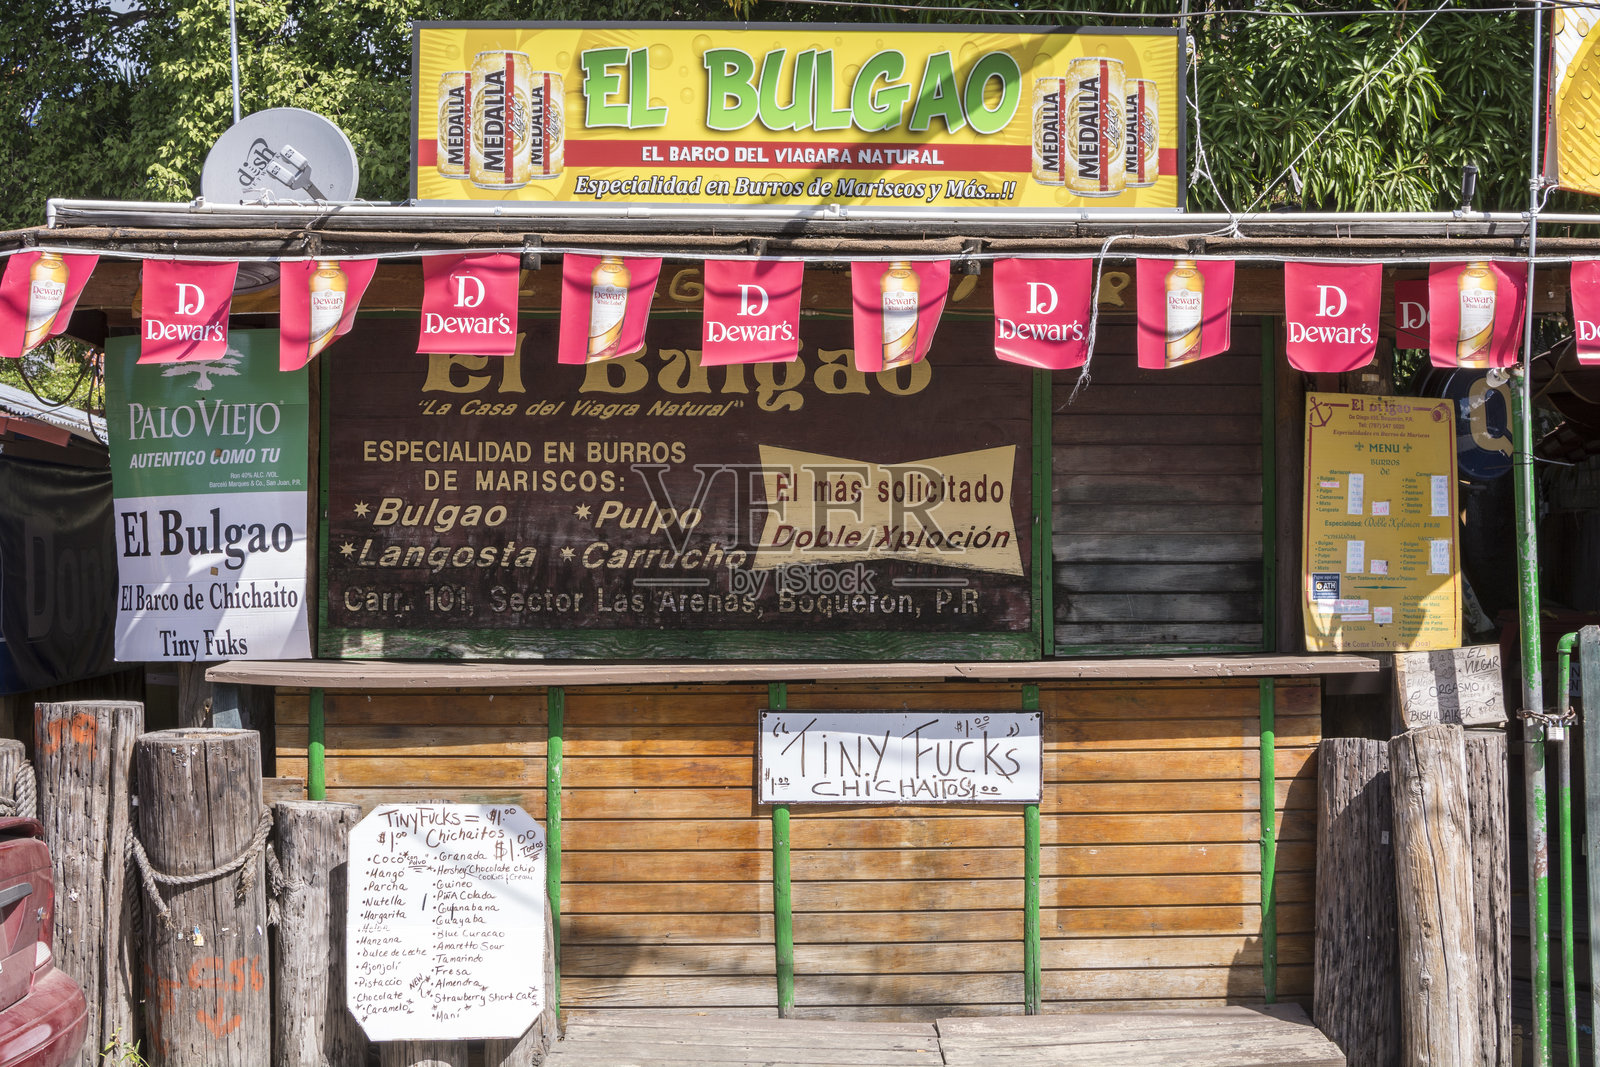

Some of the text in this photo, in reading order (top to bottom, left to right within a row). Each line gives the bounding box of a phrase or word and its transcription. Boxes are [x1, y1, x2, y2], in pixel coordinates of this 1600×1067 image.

[581, 46, 668, 129] EL
[704, 48, 1022, 134] BULGAO
[448, 84, 465, 166] MEDALLA
[483, 68, 505, 173] MEDALLA
[1078, 75, 1100, 180] MEDALLA
[1042, 92, 1059, 173] MEDALLA
[642, 147, 944, 165] EL BARCO DEL VIAGARA NATURAL
[574, 175, 701, 198] Especialidad
[706, 180, 729, 196] en
[734, 177, 804, 197] Burros
[807, 178, 831, 197] de
[836, 178, 926, 198] Mariscos
[926, 183, 943, 202] y
[460, 400, 518, 416] Casa
[525, 399, 564, 416] del
[571, 400, 641, 420] Viagra
[1351, 399, 1364, 411] El
[363, 441, 686, 463] ESPECIALIDAD EN BURROS
[1369, 443, 1400, 453] MENU
[130, 448, 281, 469] AUTENTICO COMO TU
[424, 470, 625, 492] DE MARISCOS:
[776, 473, 1004, 503] El más solicitado
[373, 498, 508, 533] Bulgao
[595, 500, 702, 534] Pulpo
[121, 507, 294, 570] El Bulgao
[772, 524, 1011, 552] Doble Xploción
[358, 539, 537, 573] Langosta
[581, 541, 747, 570] Carrucho
[121, 581, 298, 611] El Barco de Chichaito
[491, 585, 584, 613] Sector
[597, 587, 645, 613] Las
[658, 589, 764, 619] Arenas,
[779, 589, 922, 619] Boqueron,
[159, 628, 248, 662] Tiny Fuks
[1467, 647, 1486, 659] EL
[1464, 656, 1500, 674] VULGAR
[1429, 683, 1479, 697] ORGASMO
[1410, 710, 1431, 721] BUSH
[426, 826, 505, 848] Chichaitos
[439, 851, 487, 862] Granada
[468, 864, 510, 874] Chocolate
[513, 866, 535, 878] chip
[368, 880, 409, 892] Parcha
[437, 880, 473, 890] Guineo
[365, 895, 406, 907] Nutella
[460, 890, 497, 900] Colada
[438, 903, 500, 914] Guanabana
[364, 910, 407, 925] Margarita
[436, 914, 487, 926] Guayaba
[360, 936, 402, 946] Manzana
[463, 929, 505, 938] Curacao
[362, 947, 389, 957] Dulce
[391, 949, 400, 957] de
[437, 941, 505, 951] Amaretto Sour
[436, 953, 483, 963] Tamarindo
[435, 965, 471, 976] Fresa
[358, 976, 403, 988] Pistaccio
[435, 978, 482, 988] Almendra
[357, 991, 403, 1002] Chocolate
[435, 991, 487, 1007] Strawberry
[488, 992, 514, 1002] Short
[366, 1003, 409, 1015] Caramelo
